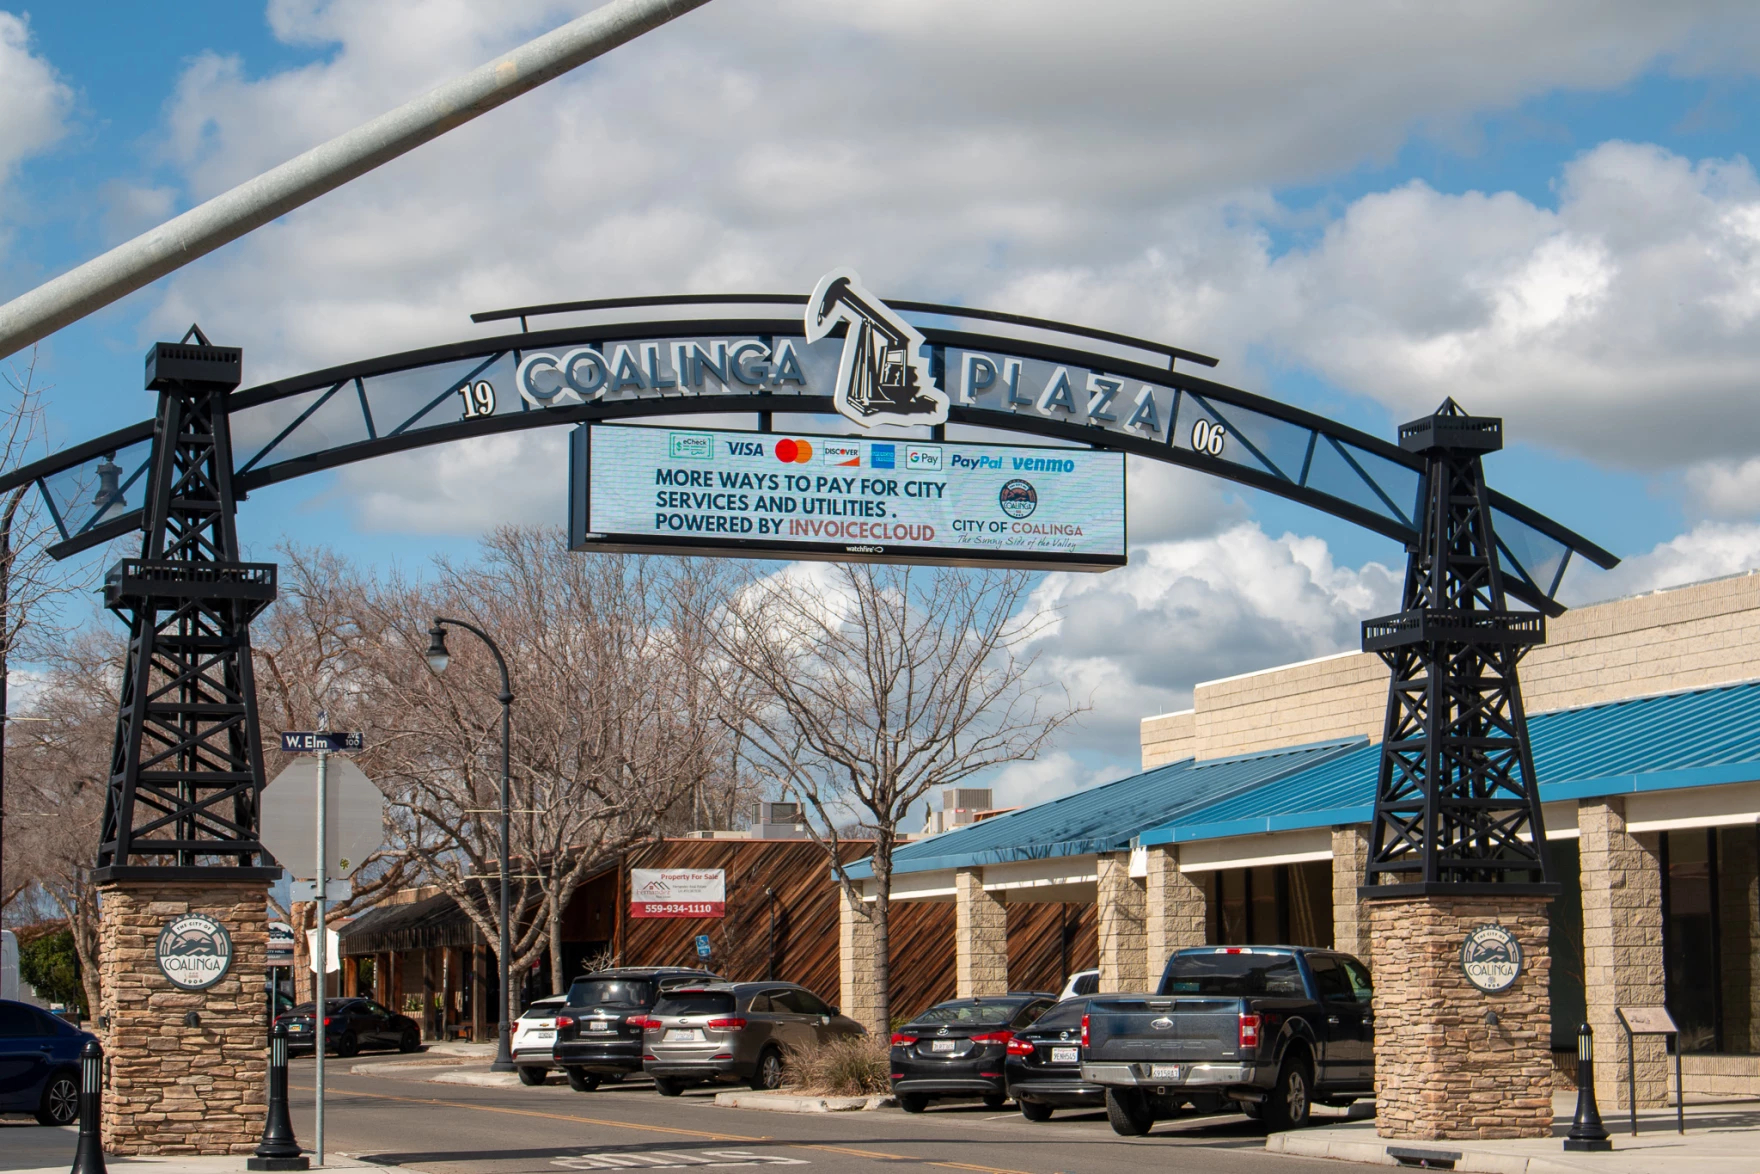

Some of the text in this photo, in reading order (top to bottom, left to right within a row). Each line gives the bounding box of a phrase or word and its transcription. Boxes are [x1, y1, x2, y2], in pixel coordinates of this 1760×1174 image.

[517, 340, 807, 404] COALINGA
[459, 380, 496, 419] 19
[961, 352, 1161, 433] PLAZA
[682, 438, 708, 446] eCheck
[1191, 418, 1226, 457] 06
[725, 441, 764, 456] VISA
[825, 448, 858, 456] DISCOVER
[910, 452, 938, 465] G Pay
[951, 454, 1002, 470] PayPal
[1012, 457, 1075, 472] venmo
[656, 468, 947, 498] MORE WAYS TO PAY FOR CITY
[656, 490, 750, 512] SERVICES
[754, 495, 797, 514] AND
[655, 513, 935, 542] POWERED BY INVOICECLOUD
[952, 520, 1083, 536] CITY OF COALINGA
[957, 533, 1076, 552] The Sunny Side of the Valley
[286, 736, 328, 748] W. Elm
[645, 904, 711, 913] 559-934-1110
[176, 923, 187, 931] THE
[164, 958, 220, 970] COALINGA
[1468, 964, 1514, 976] COALINGA
